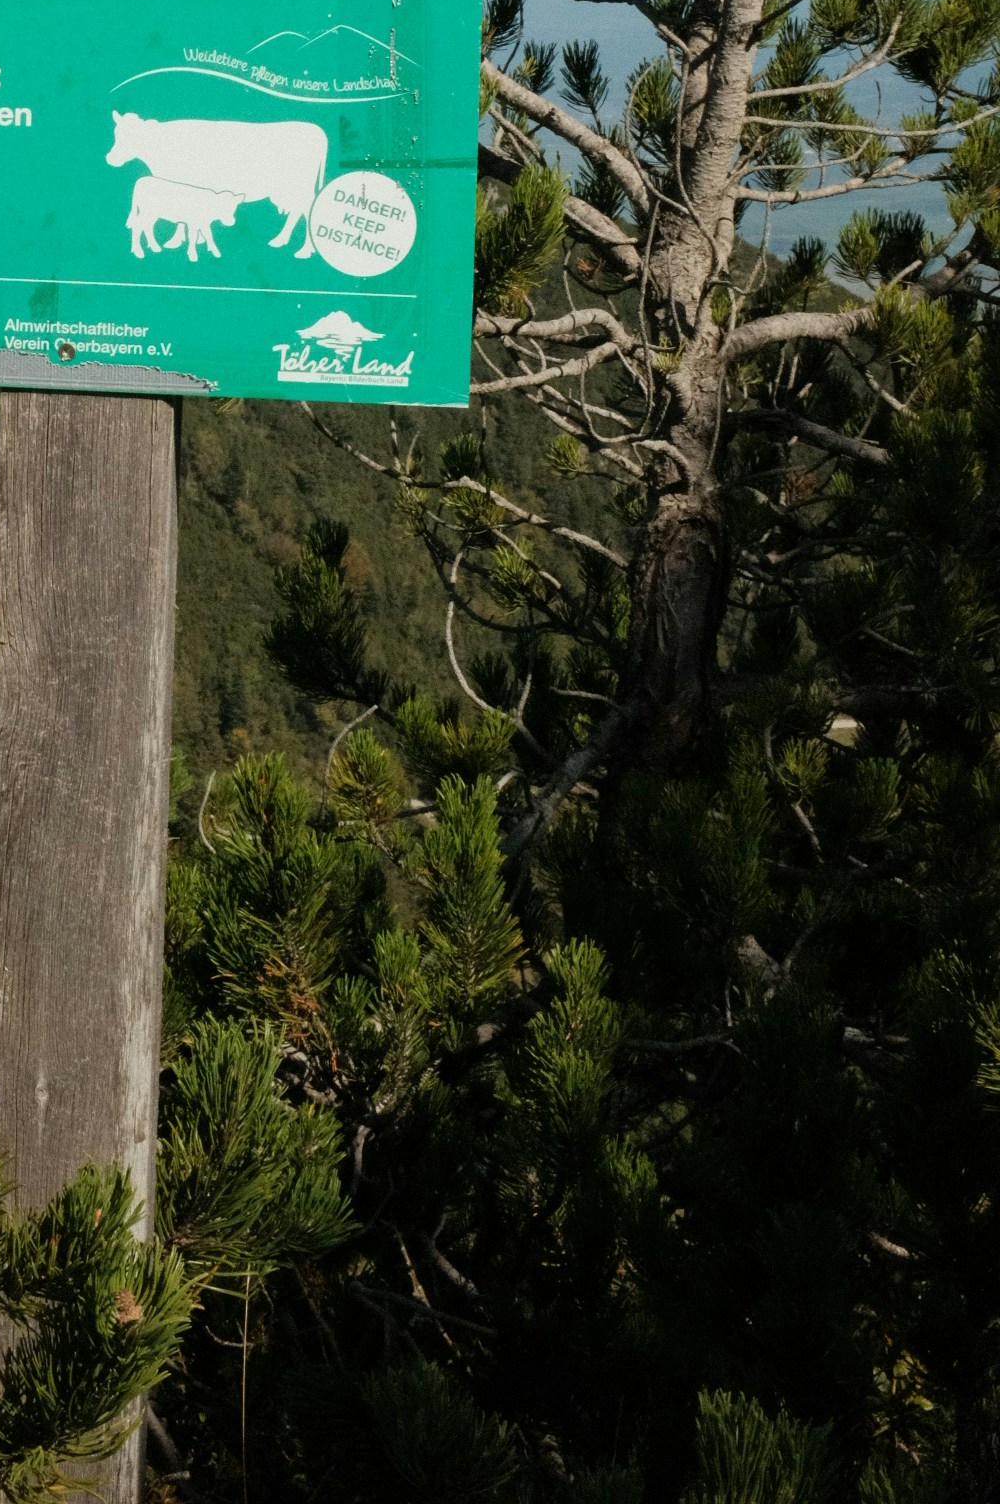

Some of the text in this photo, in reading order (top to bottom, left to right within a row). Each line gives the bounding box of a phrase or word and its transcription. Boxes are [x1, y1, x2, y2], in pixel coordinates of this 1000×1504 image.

[183, 48, 248, 71] Weidetiere
[250, 65, 290, 87] pflegen
[292, 78, 331, 92] unsere
[333, 189, 407, 223] DANGER!
[342, 212, 387, 234] KEEP
[316, 225, 401, 262] DISTANCE!
[4, 318, 149, 338] Almwirtschaftlicher
[4, 336, 50, 351] Verein
[147, 343, 174, 357] e.V.
[352, 346, 415, 376] Land
